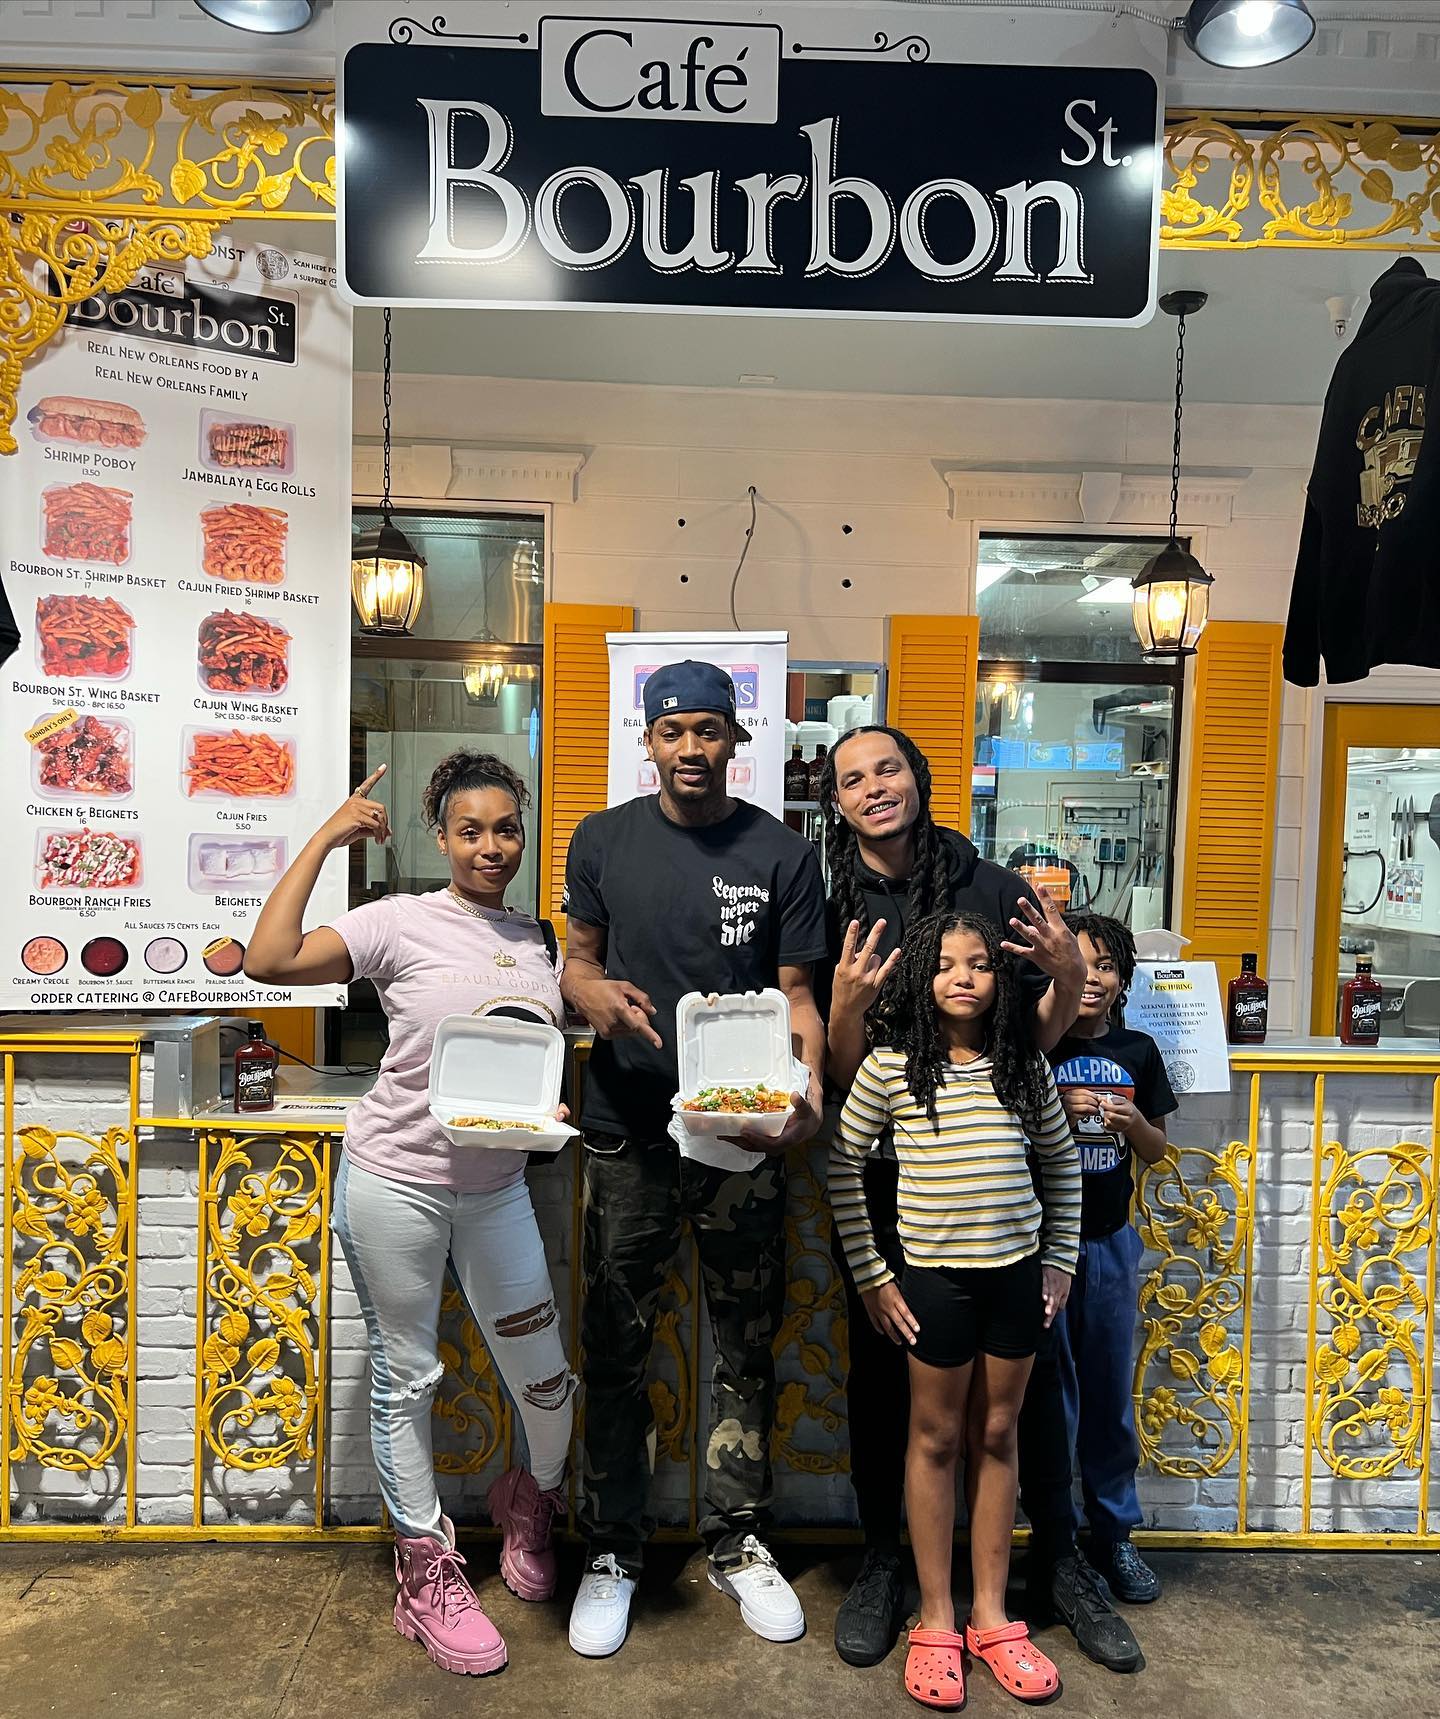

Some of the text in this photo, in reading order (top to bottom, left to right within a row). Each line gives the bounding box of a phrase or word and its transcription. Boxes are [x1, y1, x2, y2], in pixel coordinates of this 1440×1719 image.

[564, 28, 750, 113] Café
[1060, 100, 1133, 167] St.
[415, 98, 1094, 284] Bourbon
[293, 259, 310, 269] SCAN
[311, 263, 326, 272] HERE
[299, 275, 327, 286] SURPRISE
[267, 305, 290, 327] St.
[88, 341, 259, 381] REAL NEW ORLEANS FOOD BY A
[95, 366, 248, 401] REAL NEW ORLEANS FAMILY
[44, 447, 137, 472] SHRIMP POBOY
[182, 468, 316, 498] JAMBALAYA EGG ROLLS
[10, 560, 167, 588] BOURBON ST. SHRIMP BASKET
[178, 579, 320, 604] CAJUN FRIED SHRIMP BASKET
[12, 681, 161, 703] BOURBON ST. WING BASKET
[67, 699, 86, 707] 13.50
[106, 702, 125, 710] 16.50
[193, 698, 299, 716] CAJUN WING BASKET
[29, 713, 74, 741] SUNDAY'S ONLY
[623, 717, 643, 727] REAL
[748, 717, 759, 727] BY
[762, 717, 769, 727] A
[26, 804, 139, 820] CHICKEN & BEIGNETS
[216, 811, 267, 822] CAJUN FRIES
[712, 876, 770, 905] Legends
[29, 895, 151, 908] BOURBON RANCH FRIES
[215, 895, 262, 907] BEIGNETS
[721, 901, 760, 920] never
[232, 910, 247, 918] 6.25
[124, 921, 137, 929] ALL
[139, 922, 165, 930] SAUCES
[176, 922, 199, 930] CENTS
[721, 917, 756, 946] die
[12, 977, 70, 985] CREAMY CREOLE
[442, 974, 501, 986] BEAUTY
[1156, 971, 1183, 979] Bourbon
[30, 990, 292, 1004] ORDER CATERING @ CAFEBOURBONST.COM
[1057, 1059, 1122, 1083] ALL-PRO
